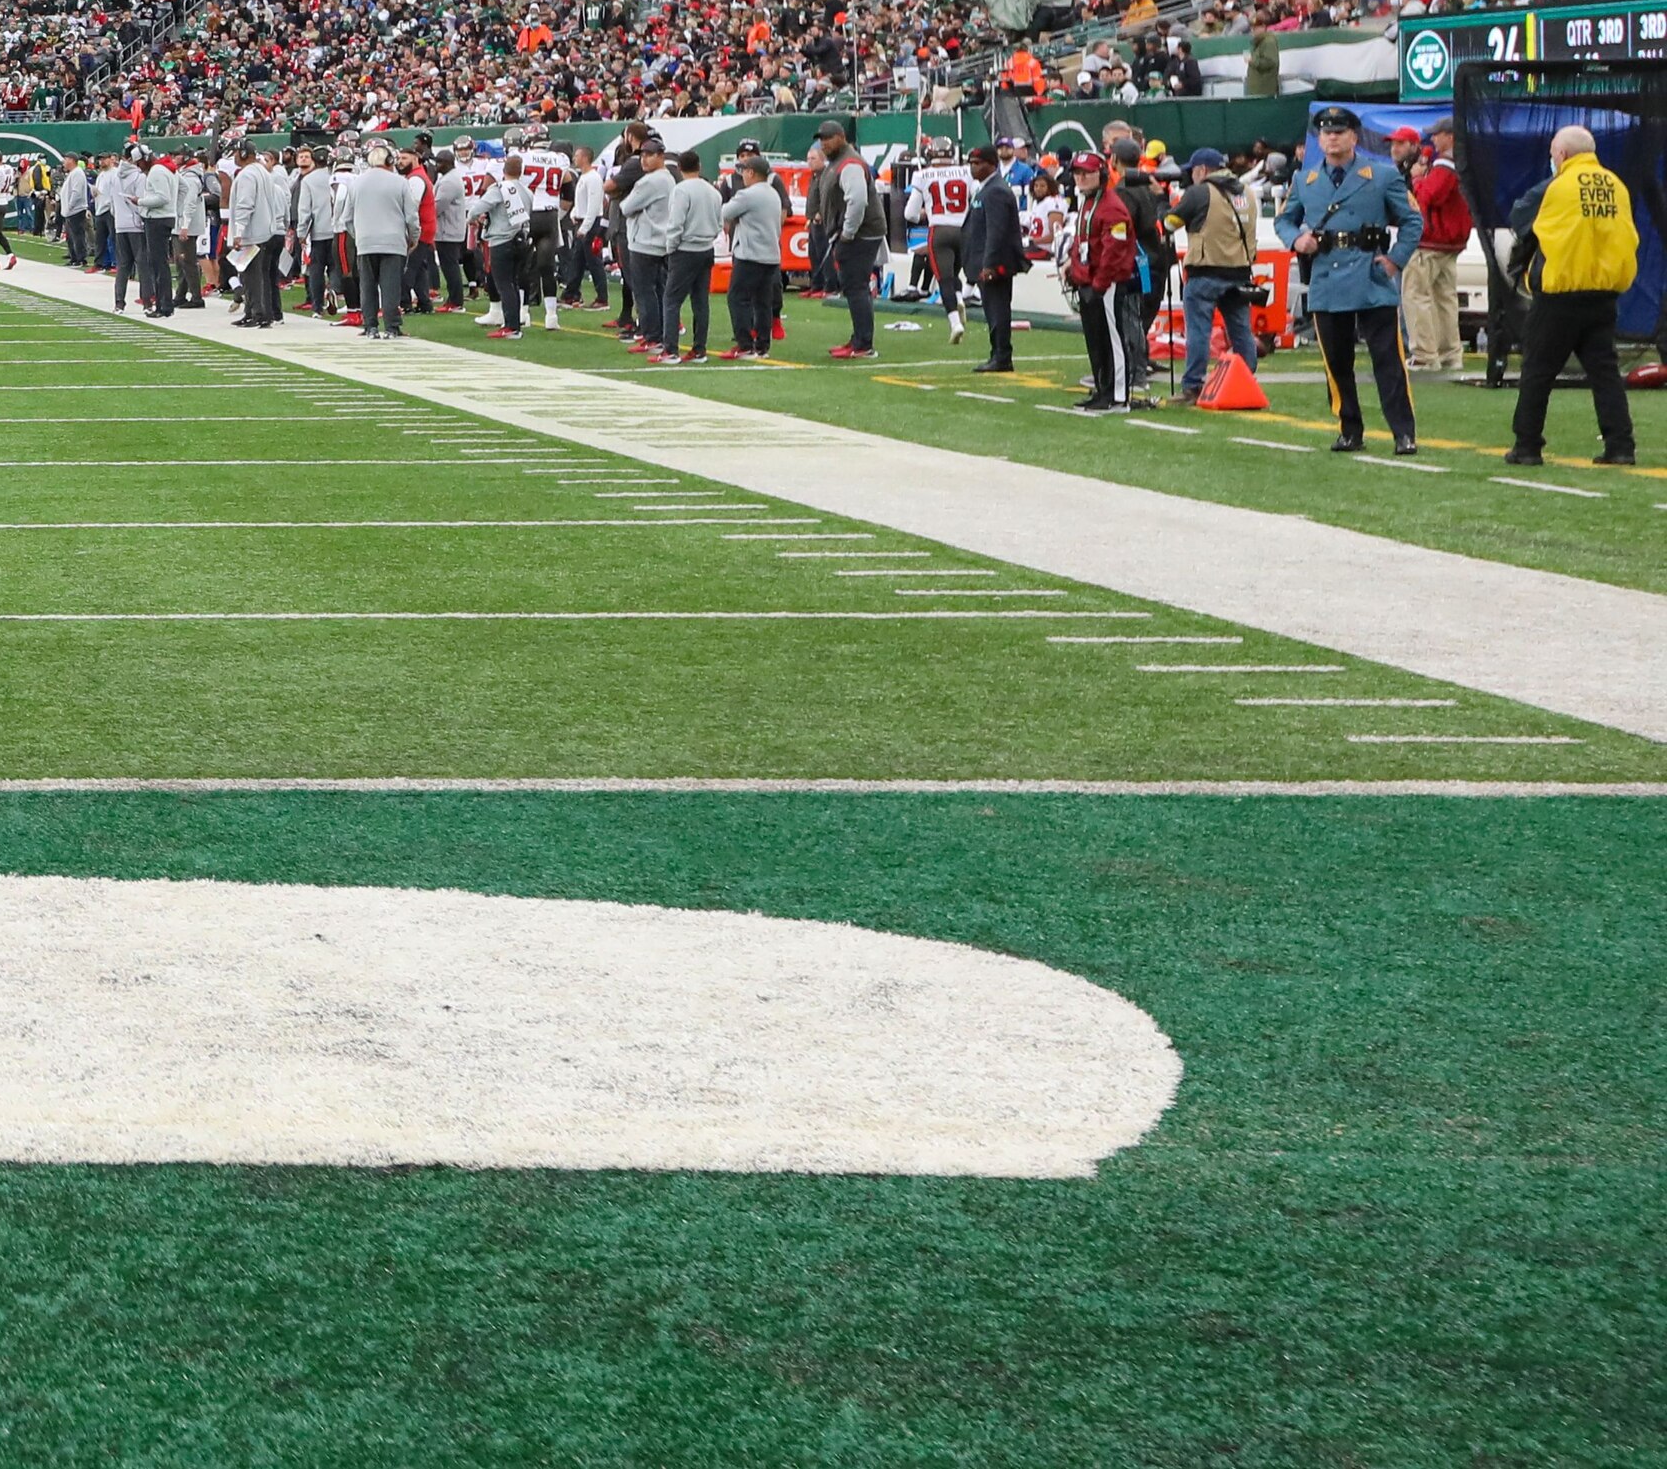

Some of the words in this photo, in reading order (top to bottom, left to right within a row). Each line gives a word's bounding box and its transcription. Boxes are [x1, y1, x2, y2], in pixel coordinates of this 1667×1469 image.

[587, 6, 600, 20] 10
[1567, 20, 1592, 47] QTR
[1598, 18, 1625, 44] 3RD
[1639, 12, 1666, 40] 3RD
[1412, 52, 1443, 70] JETS
[523, 165, 564, 197] 70
[1577, 173, 1615, 189] CSC
[928, 179, 968, 215] 19
[1580, 188, 1616, 204] EVENT
[1582, 203, 1618, 220] STAFF
[1199, 358, 1234, 404] 20
